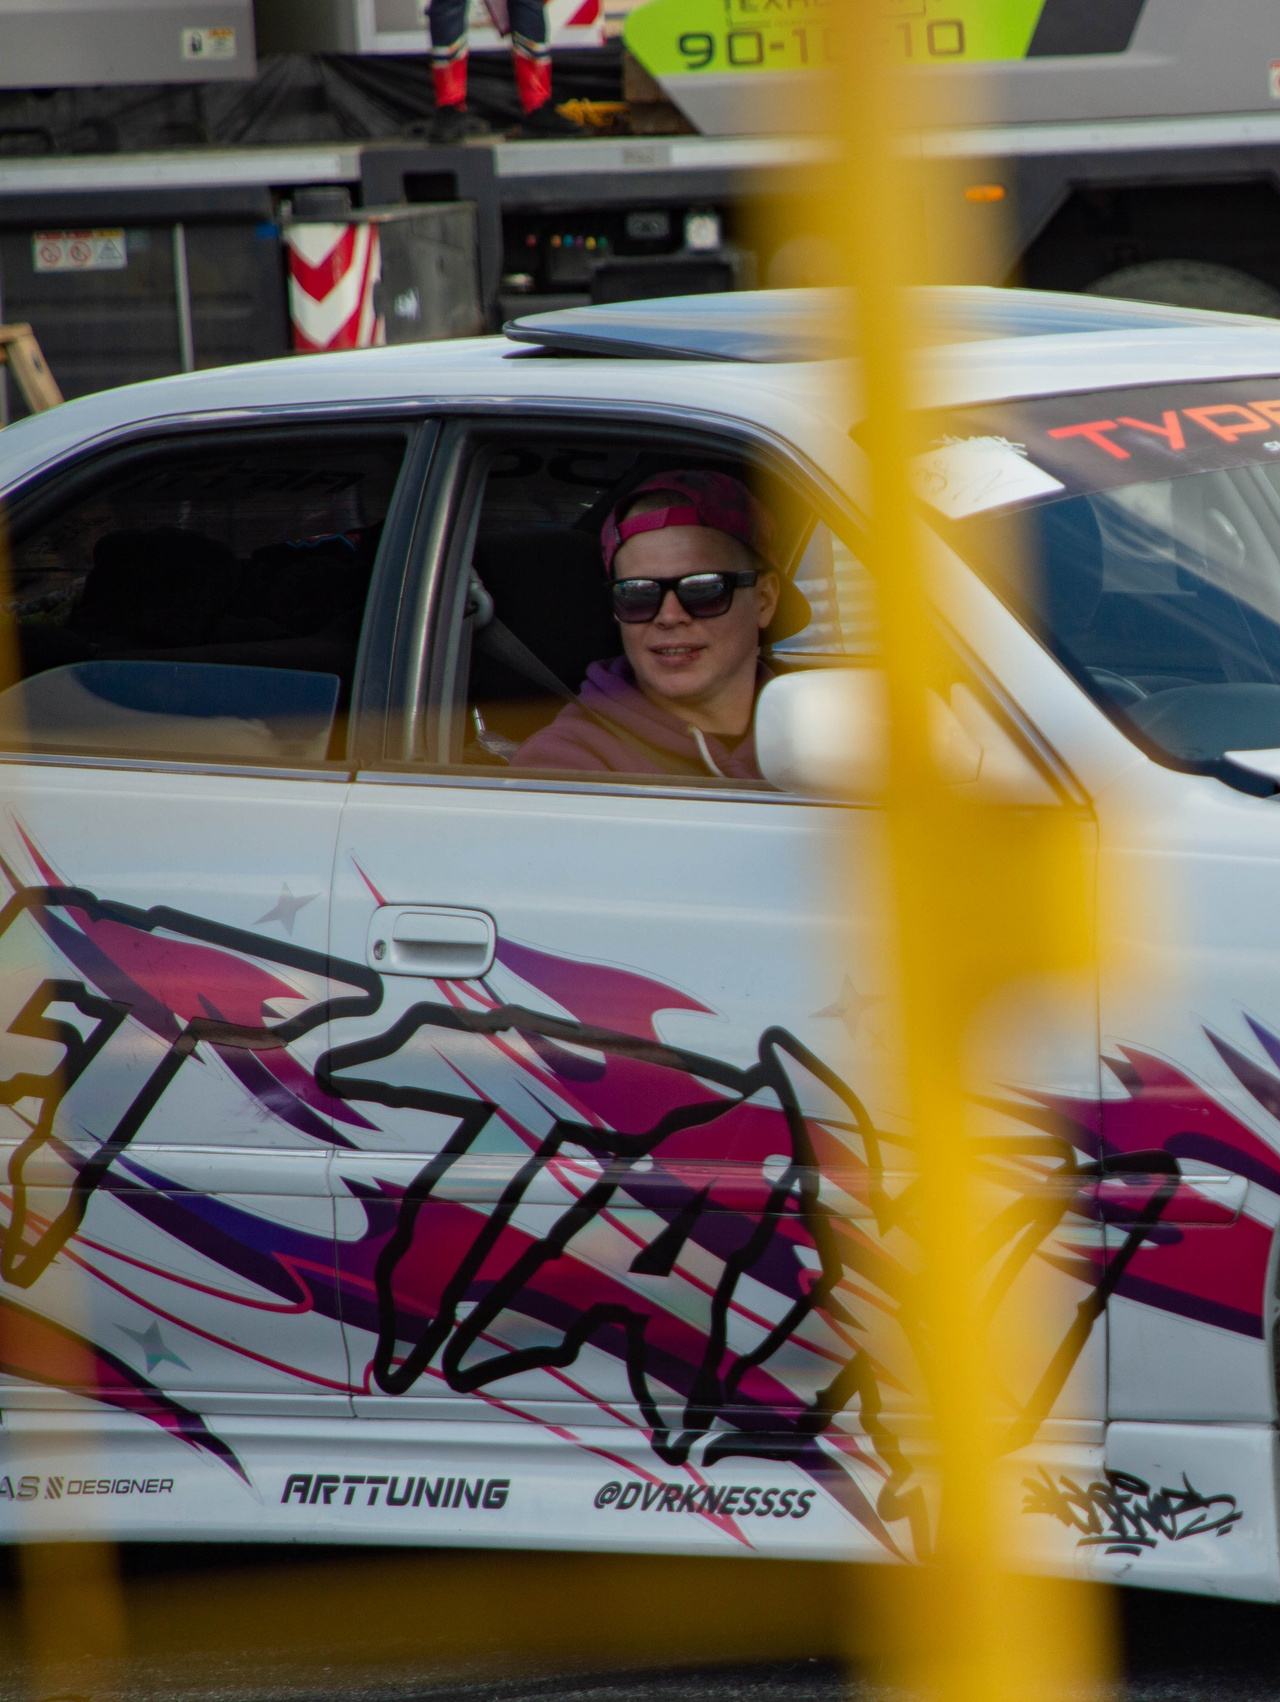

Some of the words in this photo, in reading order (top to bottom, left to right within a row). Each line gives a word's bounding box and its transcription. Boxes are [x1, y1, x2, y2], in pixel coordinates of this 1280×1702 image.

[65, 1478, 174, 1496] DESIGNER
[280, 1472, 511, 1510] ARTTUNING
[593, 1479, 817, 1520] @DVRKNESSSS
